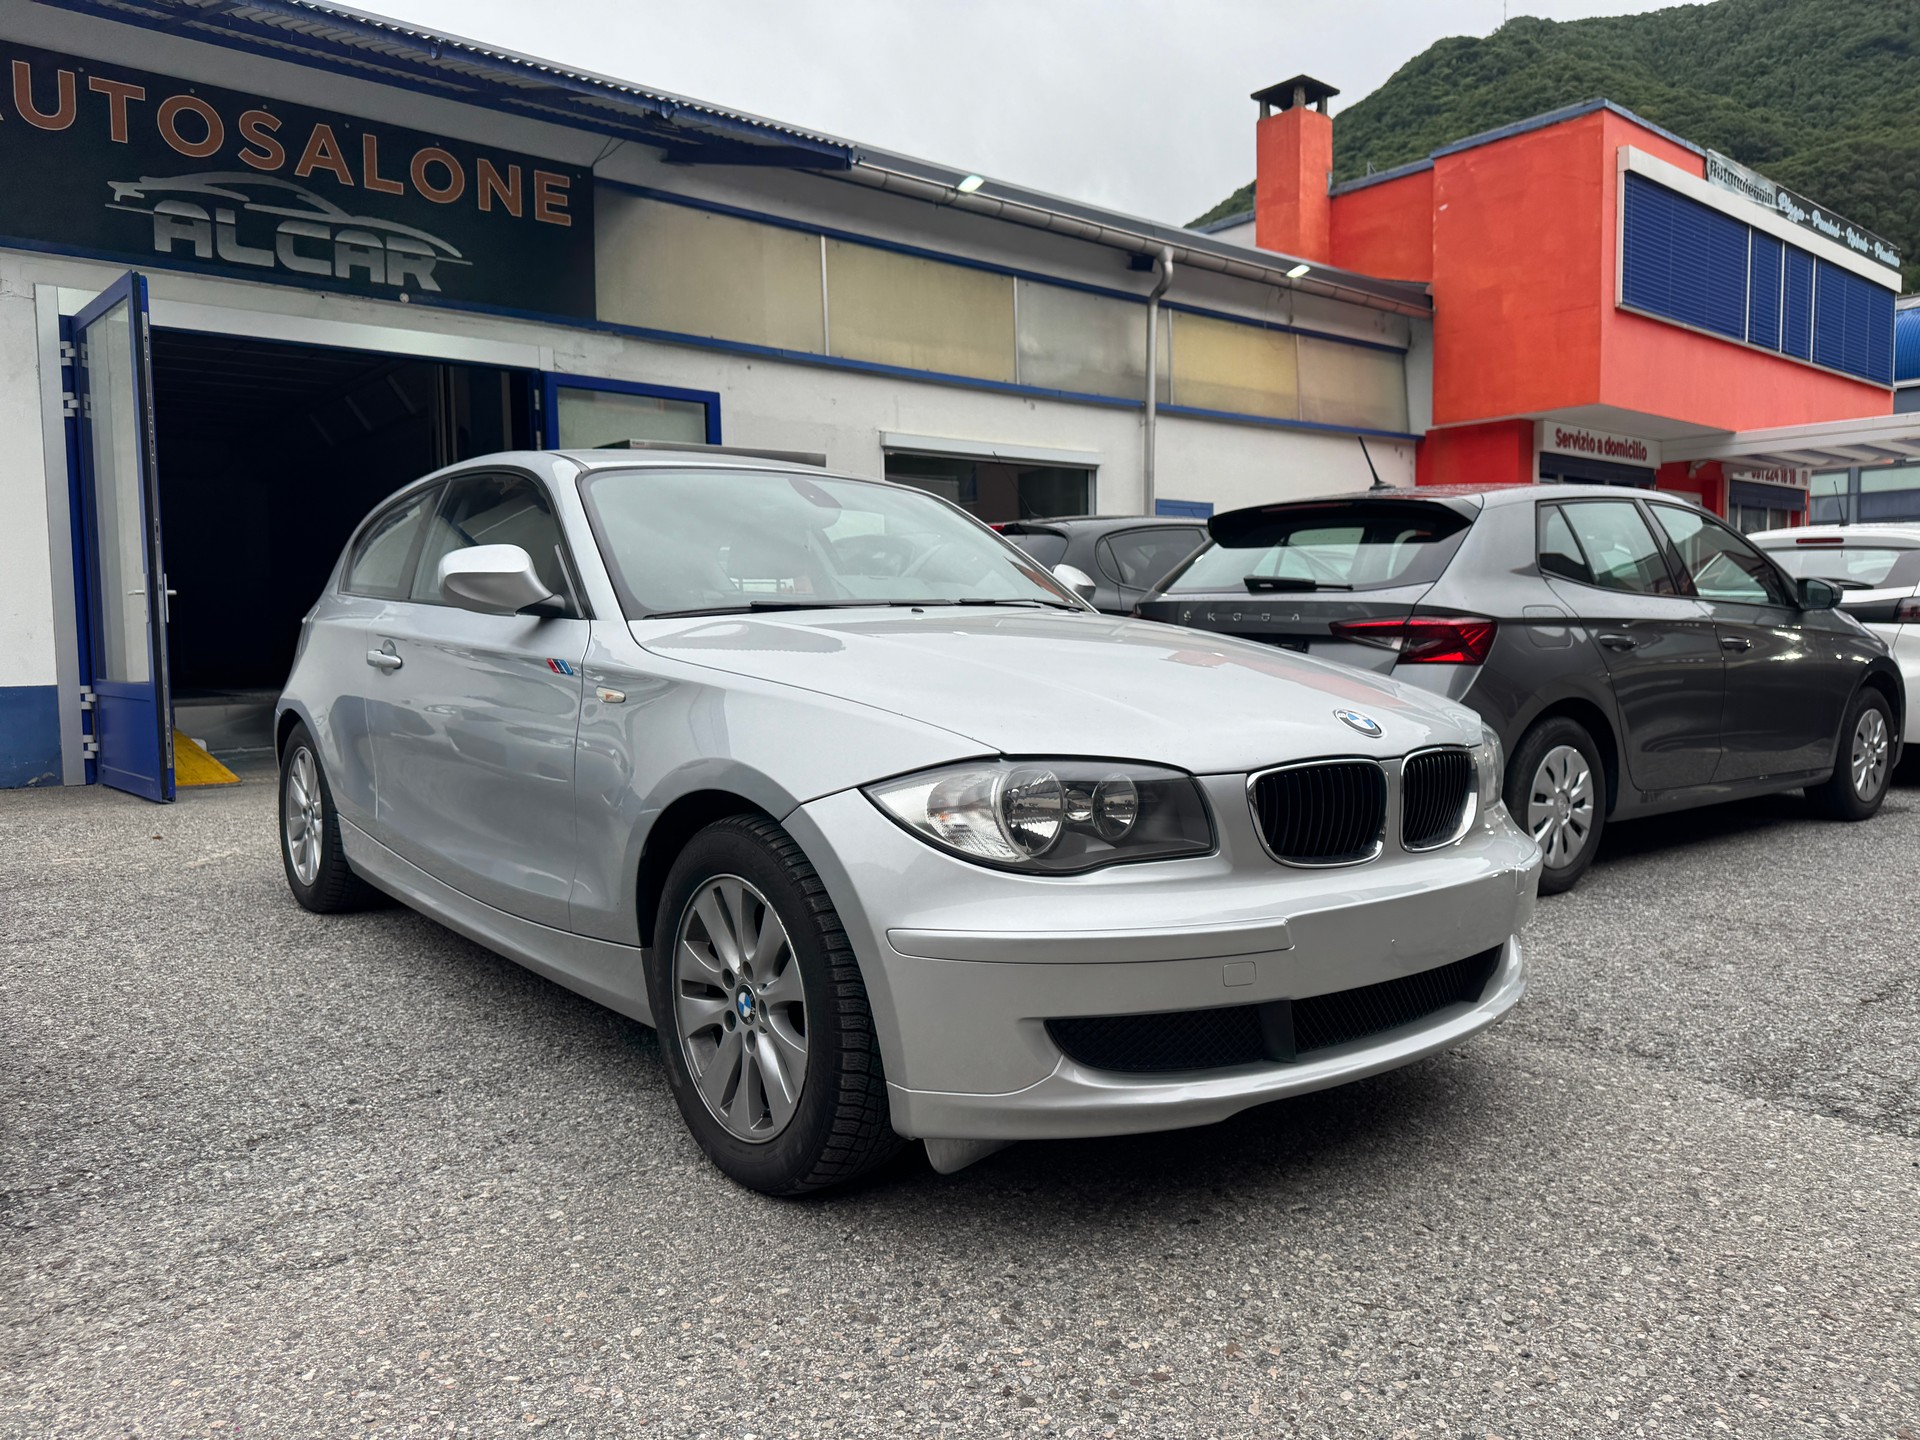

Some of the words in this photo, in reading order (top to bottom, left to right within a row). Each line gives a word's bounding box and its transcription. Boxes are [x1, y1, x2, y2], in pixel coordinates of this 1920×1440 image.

[0, 60, 572, 227] UTOSALONE
[153, 199, 442, 292] ALCAR
[1555, 427, 1596, 454] Servizio
[1597, 437, 1603, 455] a
[1604, 435, 1648, 461] domicilio
